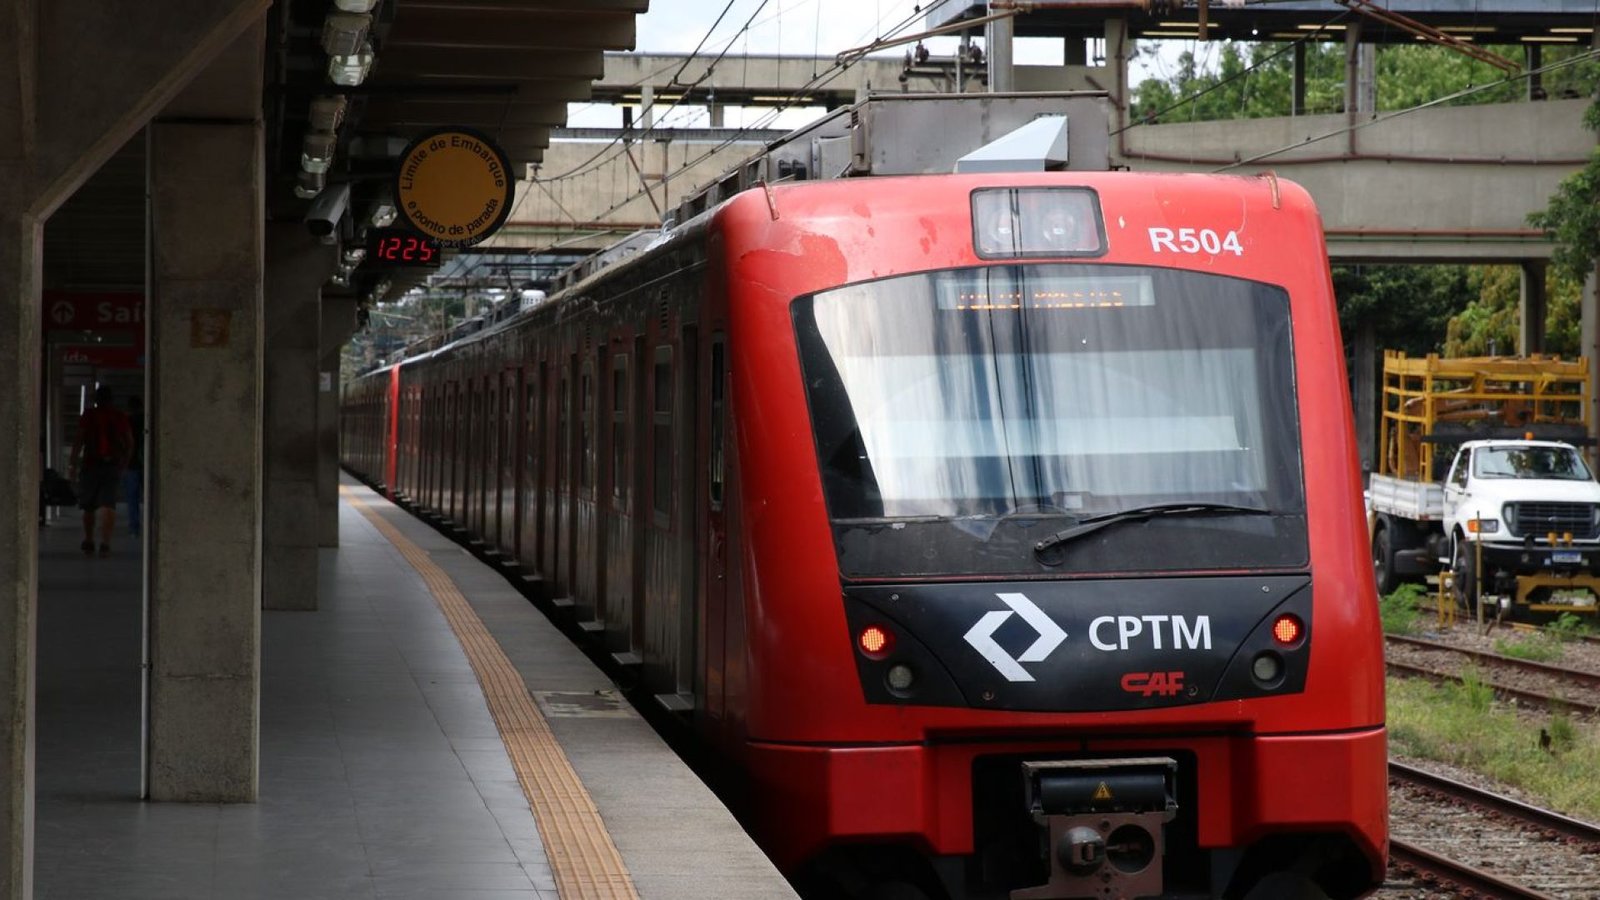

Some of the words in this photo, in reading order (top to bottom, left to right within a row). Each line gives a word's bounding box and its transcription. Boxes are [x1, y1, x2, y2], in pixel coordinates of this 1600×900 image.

[402, 150, 427, 190] Limite
[430, 139, 446, 151] de
[451, 136, 504, 187] Embarque
[408, 201, 417, 209] e
[466, 198, 498, 234] parada
[411, 209, 446, 234] ponto
[448, 224, 464, 235] de
[1148, 227, 1244, 256] R504
[97, 301, 145, 323] Saí
[1088, 615, 1212, 651] CPTM
[1121, 671, 1184, 697] CAF
